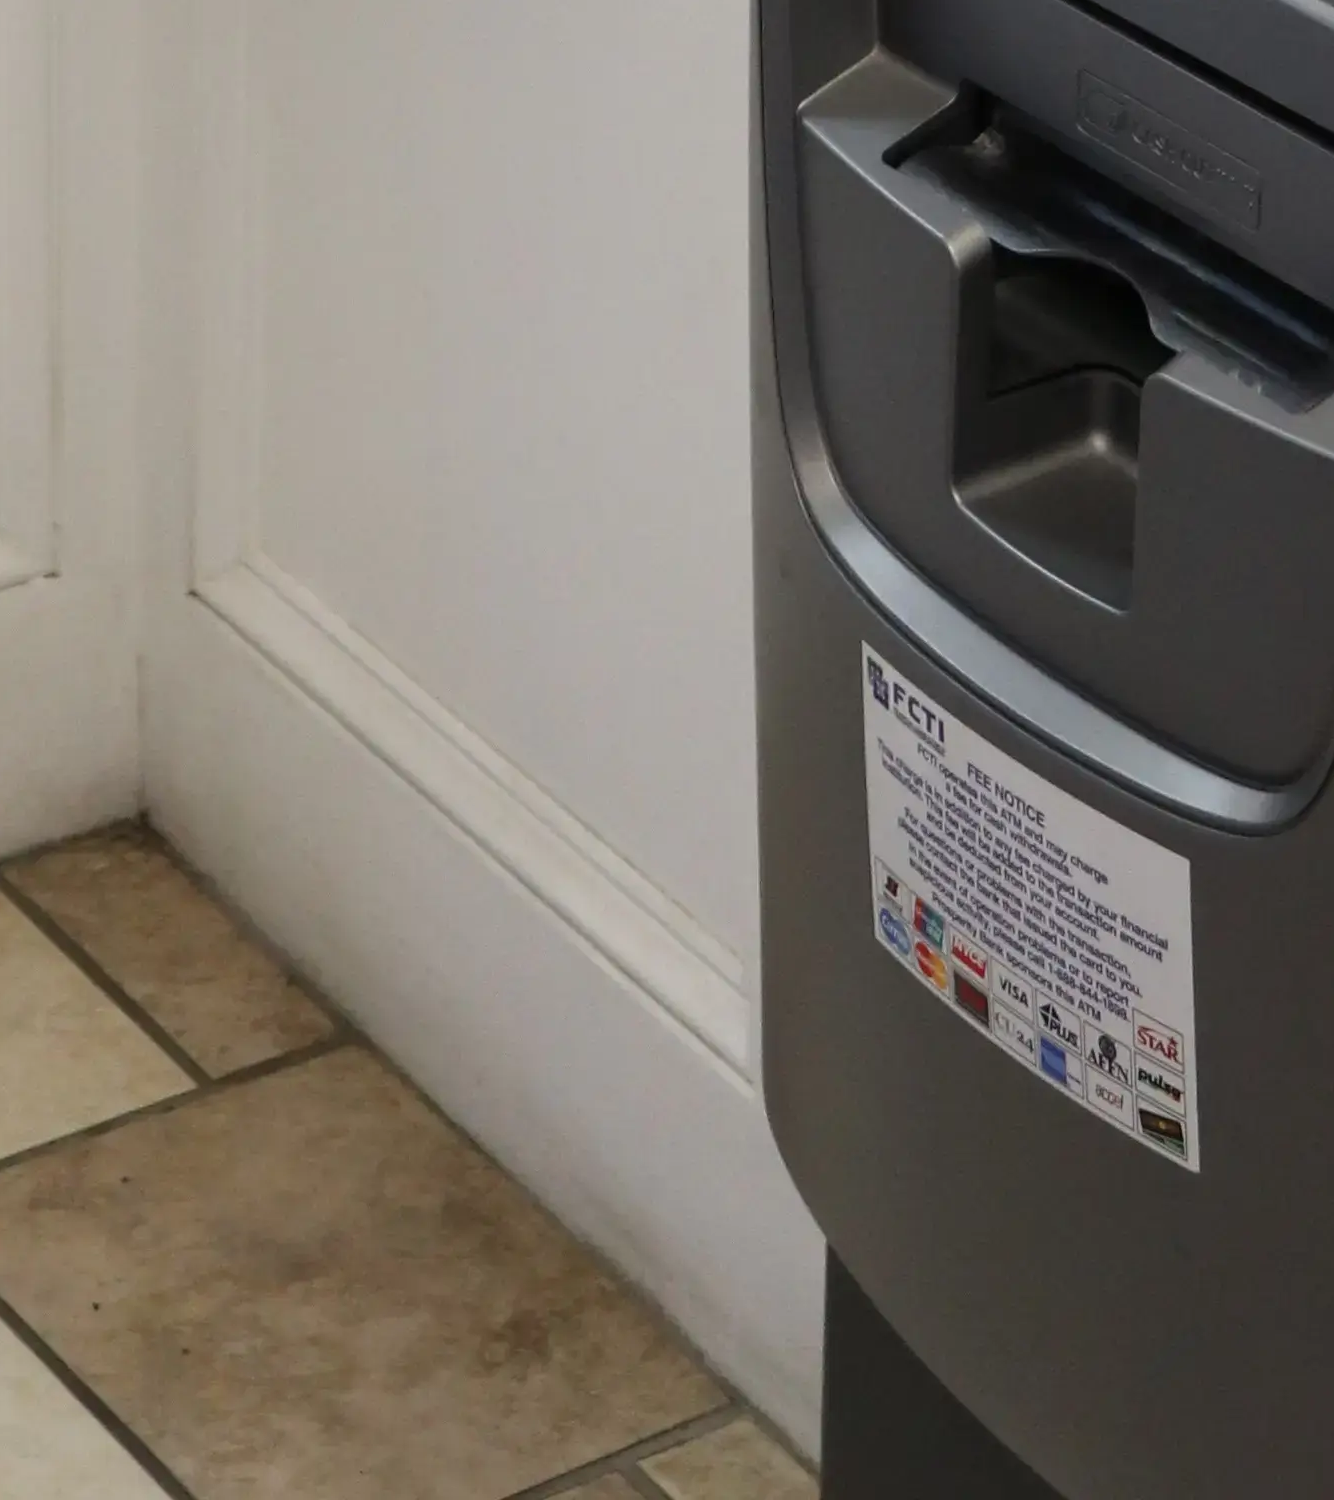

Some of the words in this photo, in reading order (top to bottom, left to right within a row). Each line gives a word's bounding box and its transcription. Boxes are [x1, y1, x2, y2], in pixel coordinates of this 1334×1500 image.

[892, 681, 944, 744] FCTI
[967, 762, 991, 792] FEE
[994, 780, 1045, 830] NOTICE
[1120, 913, 1168, 952] financial
[1079, 950, 1103, 975] card
[999, 974, 1029, 1007] VISA
[1095, 978, 1128, 1010] report
[1049, 1020, 1078, 1049] PLUS
[1137, 1026, 1179, 1063] STAR
